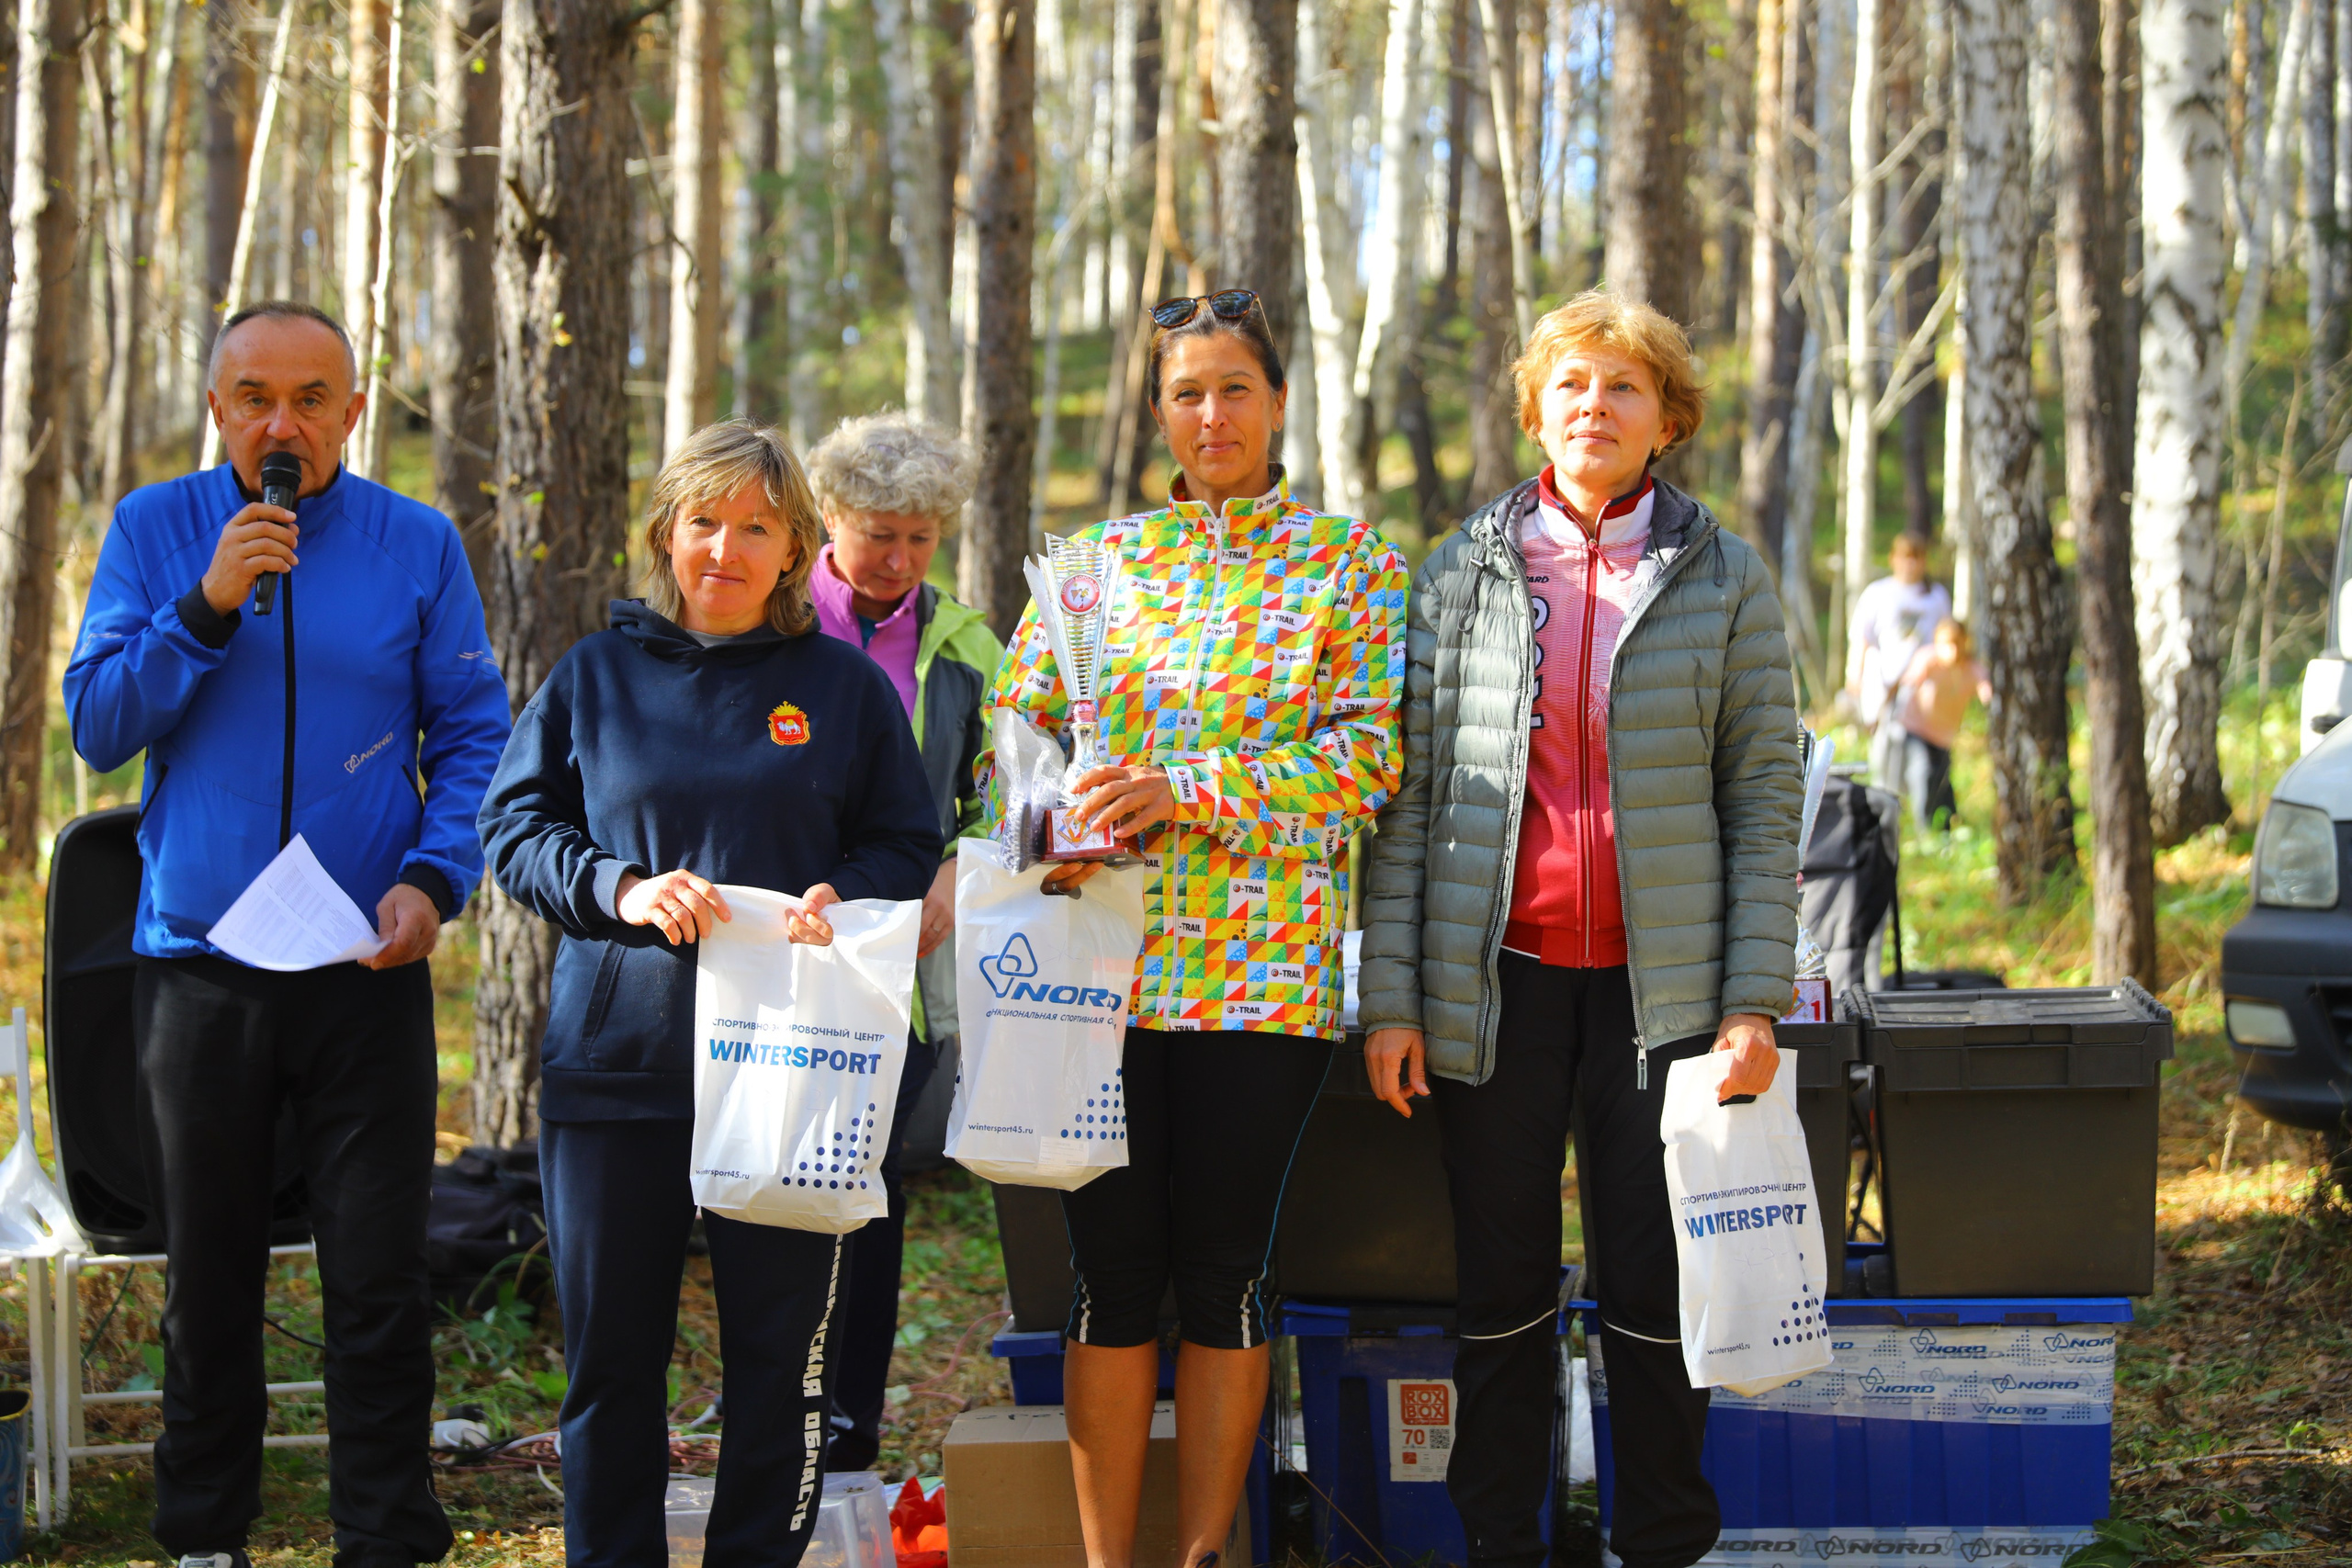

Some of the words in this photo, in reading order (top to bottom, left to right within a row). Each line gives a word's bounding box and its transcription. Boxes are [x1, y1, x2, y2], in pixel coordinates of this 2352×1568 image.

[360, 731, 394, 762] NORD
[1011, 982, 1122, 1011] NORD
[1811, 1000, 1821, 1021] 1
[854, 1032, 885, 1042] ЦЕНТР
[709, 1038, 882, 1075] WINTERSPORT
[967, 1122, 1034, 1134] wintersport45.ru
[1782, 1183, 1807, 1192] ЦЕНТР
[1926, 1345, 1987, 1354] NORD
[1875, 1384, 1935, 1393] NORD
[2015, 1381, 2079, 1390] NORD
[1407, 1391, 1443, 1404] ROX
[1407, 1405, 1443, 1418] BOX
[1985, 1405, 2048, 1416] NORD
[1401, 1428, 1425, 1445] 70
[1848, 1542, 1942, 1554] NORD
